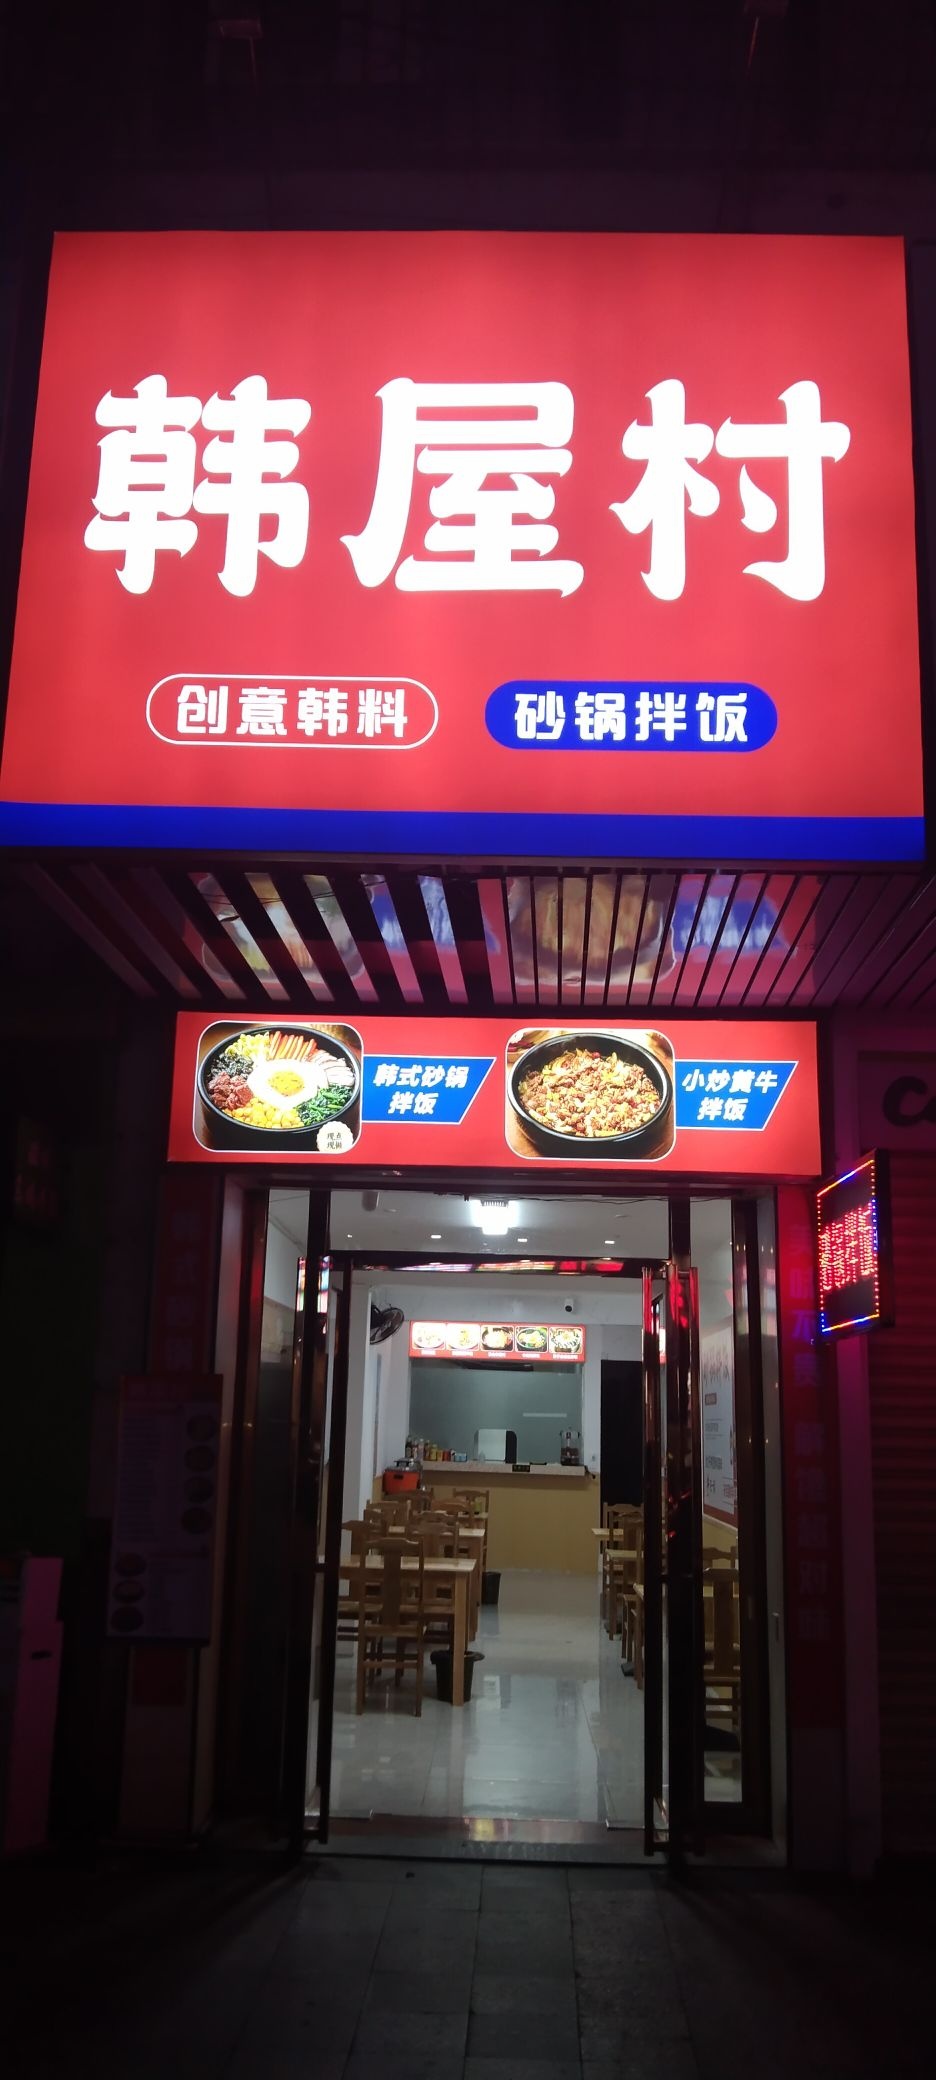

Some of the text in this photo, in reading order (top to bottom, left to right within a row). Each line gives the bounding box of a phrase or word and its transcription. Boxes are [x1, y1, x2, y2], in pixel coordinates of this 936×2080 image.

[84, 375, 851, 601] 韩屋村
[177, 684, 408, 738] 创意韩料
[514, 690, 748, 742] 砂锅拌饭
[373, 1063, 470, 1089] 韩式砂锅
[682, 1068, 778, 1094] 小炒黄牛
[387, 1091, 439, 1115] 拌饭
[697, 1097, 749, 1121] 拌饭
